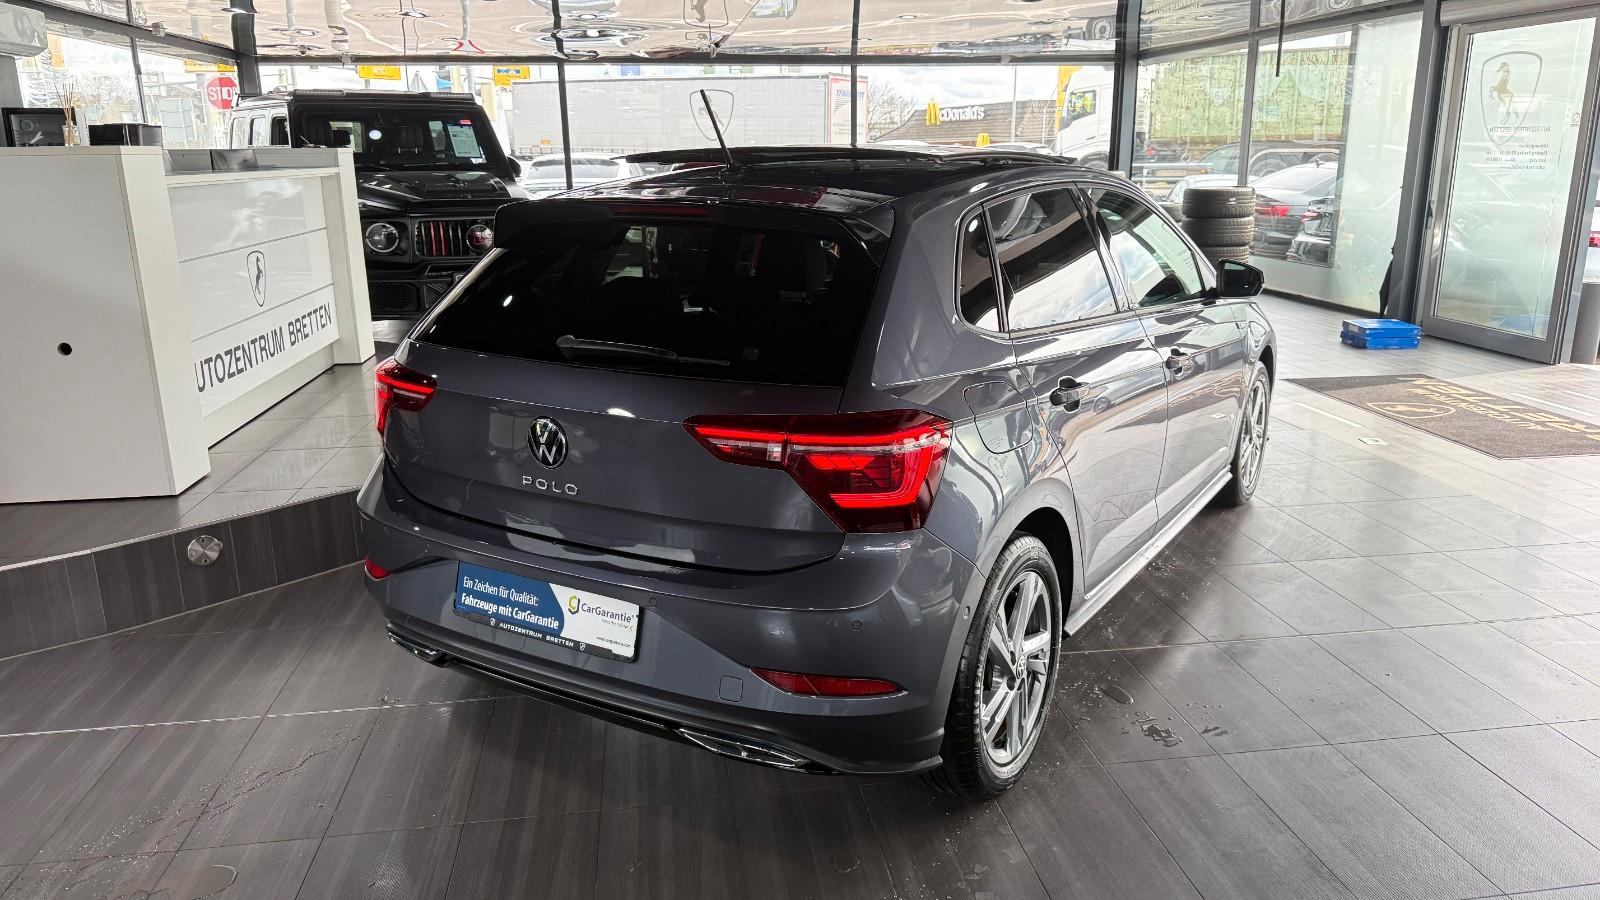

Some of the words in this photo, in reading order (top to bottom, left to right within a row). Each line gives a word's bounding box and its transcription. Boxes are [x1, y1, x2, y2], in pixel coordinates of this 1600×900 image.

[208, 86, 238, 101] STOP
[926, 102, 985, 126] McDonald's
[194, 326, 286, 393] UTOZENTRUM
[287, 302, 332, 347] BRETTEN
[1396, 377, 1600, 442] RETTEN
[522, 475, 578, 496] POLO
[463, 576, 473, 589] Ein
[473, 579, 498, 596] Zeichen
[499, 586, 510, 598] für
[509, 588, 539, 606] Qualität:
[461, 592, 498, 614] Fahrzeuge
[498, 604, 513, 617] mit
[512, 607, 559, 630] CarGarantie
[499, 622, 543, 639] AUTOZENTRUM
[545, 635, 574, 647] BRETTEN
